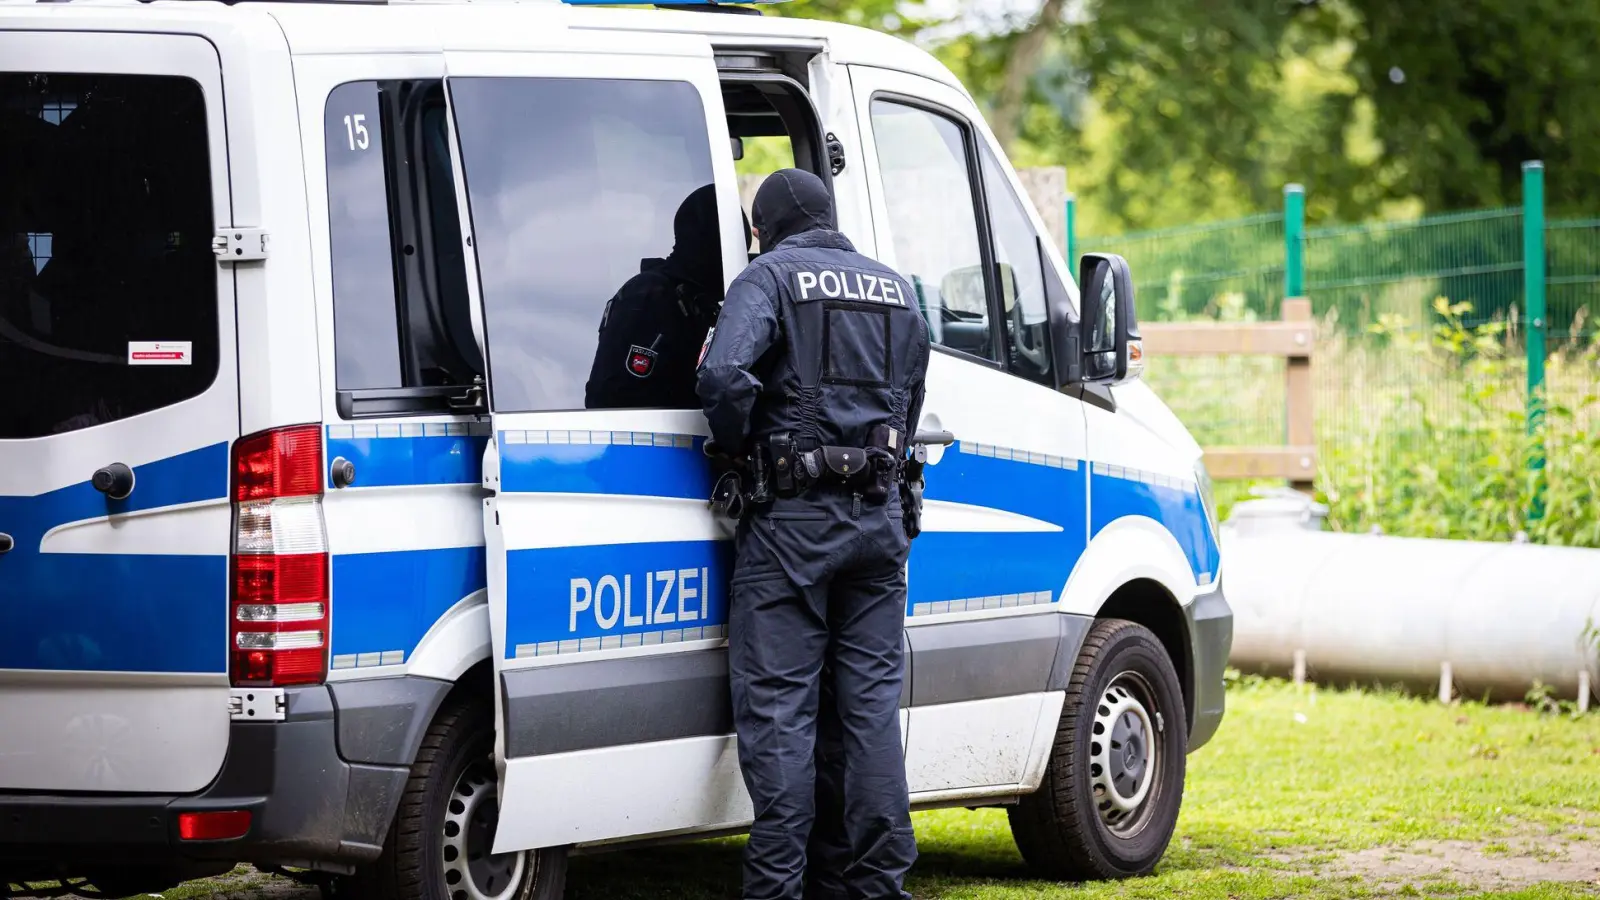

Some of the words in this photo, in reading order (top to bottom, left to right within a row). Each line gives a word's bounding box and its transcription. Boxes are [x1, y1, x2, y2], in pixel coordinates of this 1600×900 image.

[343, 113, 369, 151] 15
[796, 270, 905, 306] POLIZEI
[569, 567, 708, 632] POLIZEI
